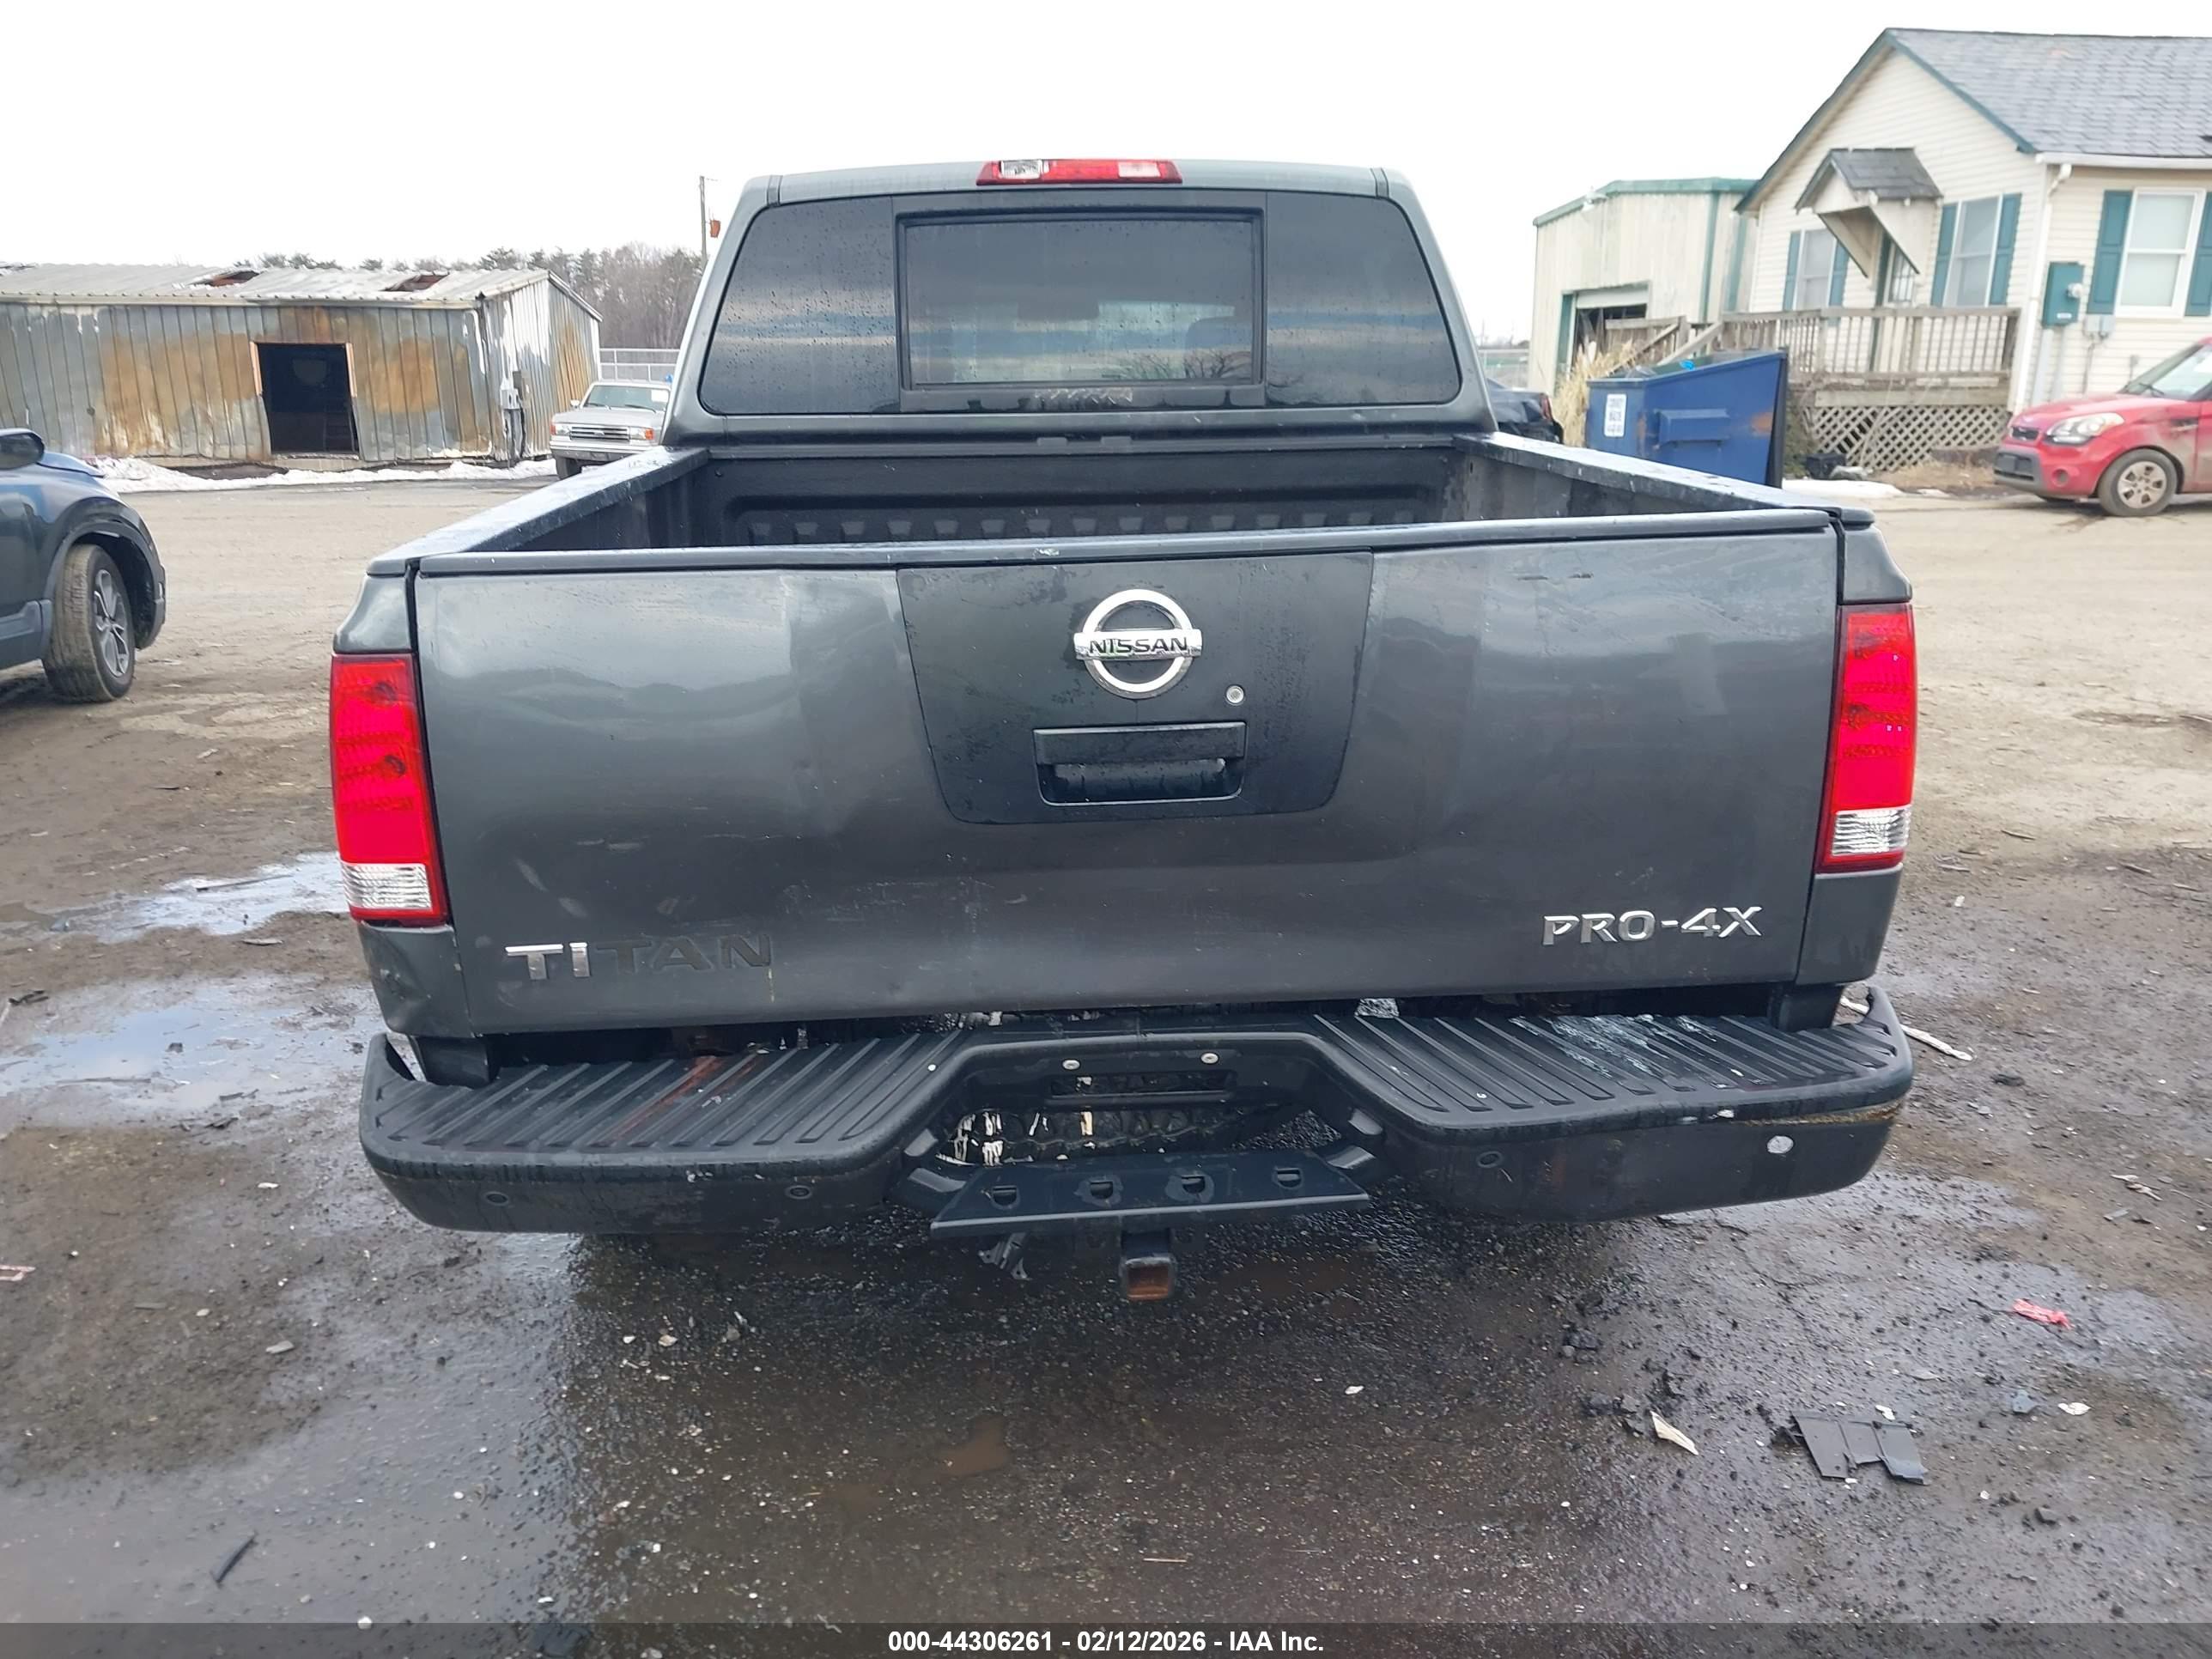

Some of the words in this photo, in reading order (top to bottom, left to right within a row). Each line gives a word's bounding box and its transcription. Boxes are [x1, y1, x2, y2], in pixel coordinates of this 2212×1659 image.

[1089, 636, 1188, 654] NISSAN
[1542, 906, 1763, 945] PRO-4X
[505, 934, 772, 981] TITAN
